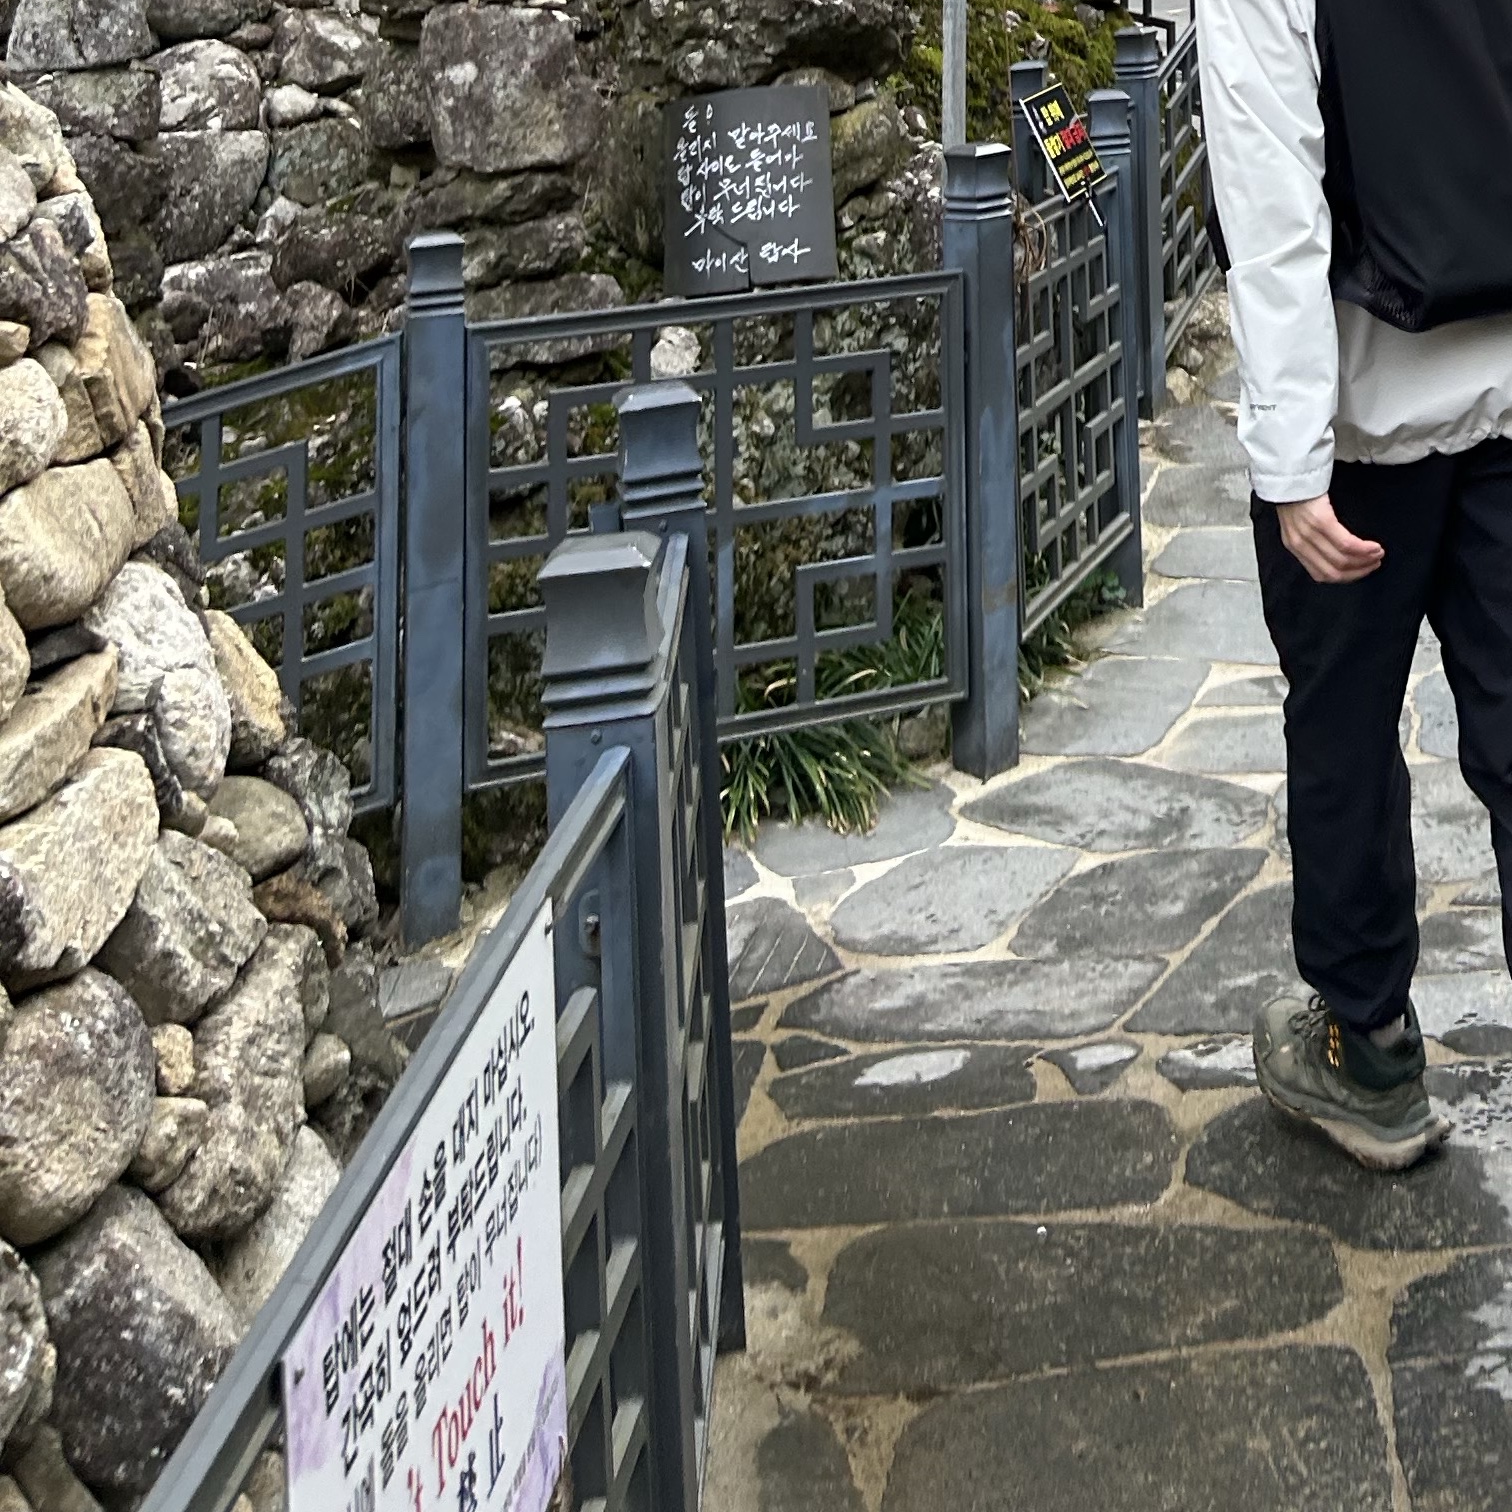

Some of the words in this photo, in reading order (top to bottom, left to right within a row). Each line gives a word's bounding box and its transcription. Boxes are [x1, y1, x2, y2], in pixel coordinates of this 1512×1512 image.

[692, 247, 749, 280] 마이산
[759, 238, 811, 264] 탑사
[323, 1285, 375, 1419] 탑에는
[382, 1197, 413, 1308] 절대
[419, 1140, 446, 1238] 손을
[453, 1077, 479, 1168] 대지
[342, 1327, 391, 1479] 간곡히
[397, 1229, 442, 1369] 엎드려
[381, 1391, 408, 1491] 돌을
[414, 1295, 453, 1420] 올리면
[457, 1234, 482, 1329] 탑이
[432, 1316, 496, 1500] Touch
[503, 1236, 525, 1348] it!
